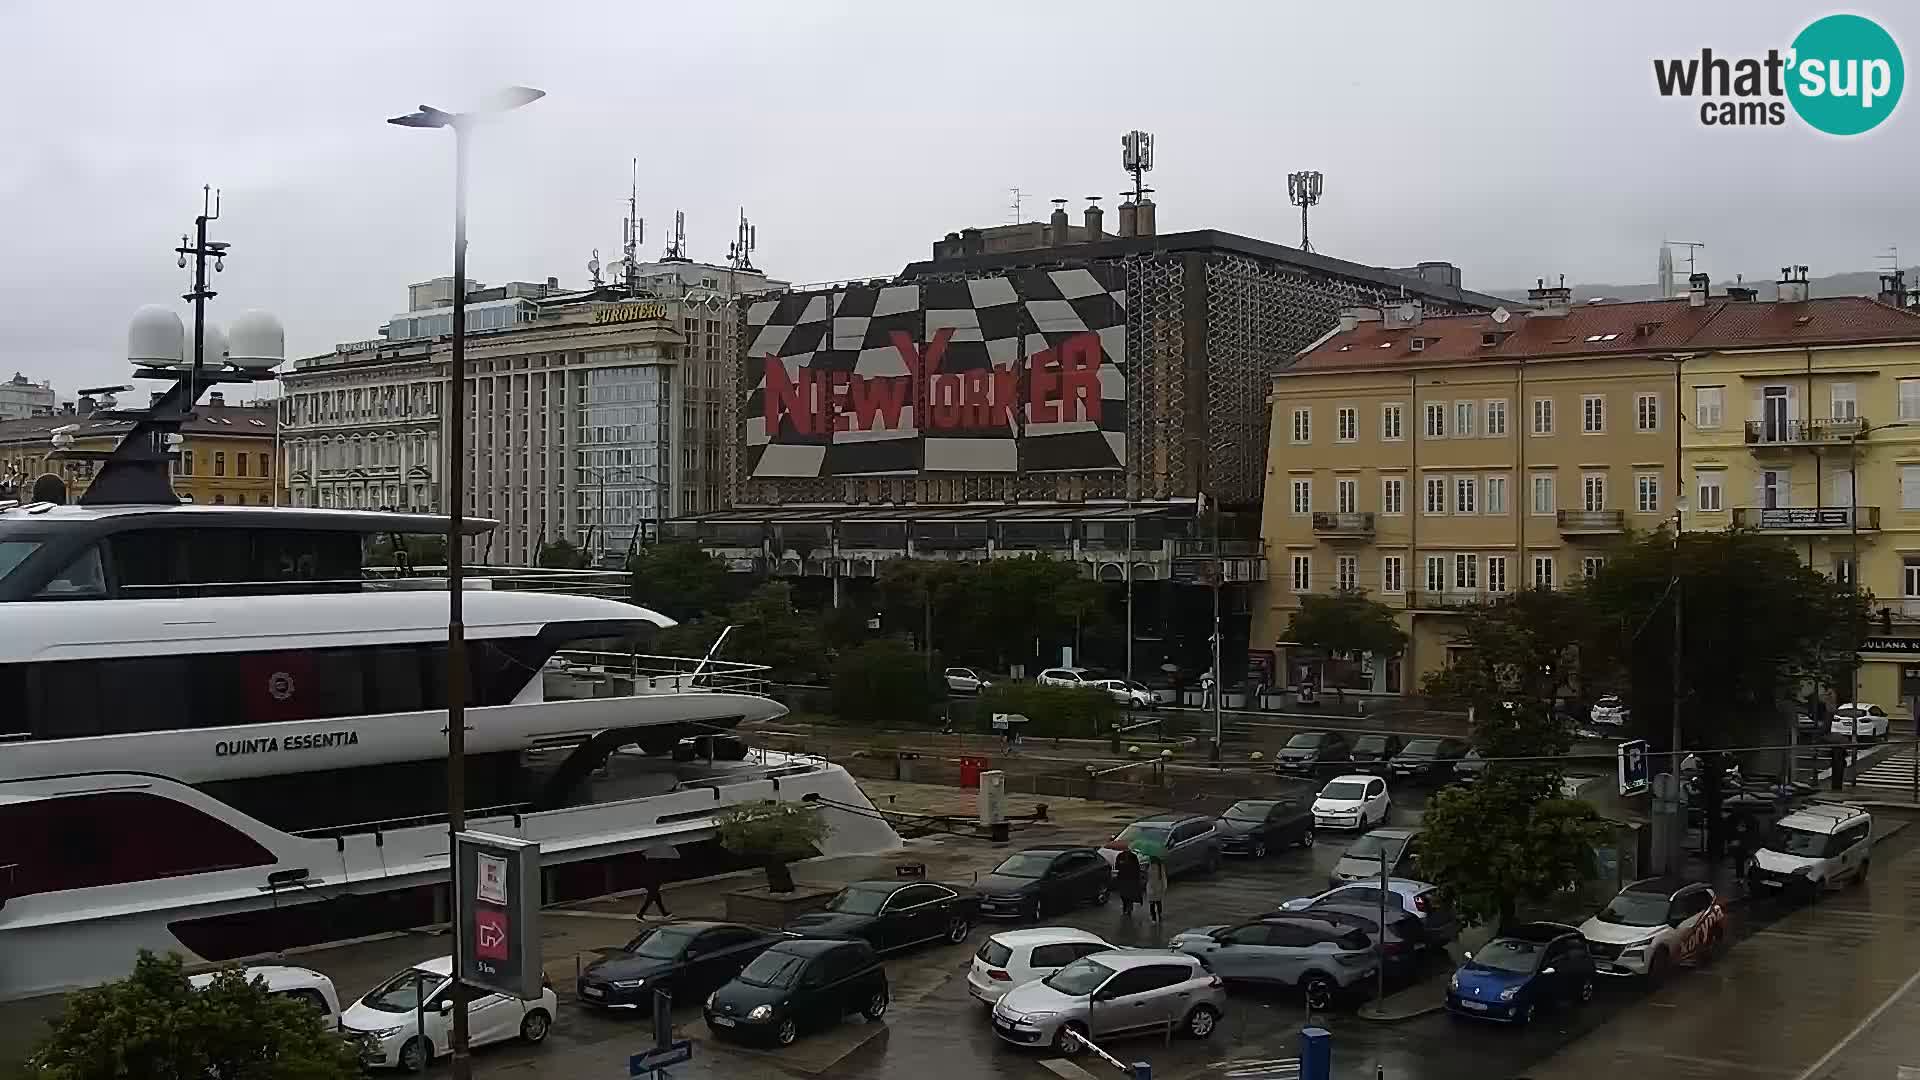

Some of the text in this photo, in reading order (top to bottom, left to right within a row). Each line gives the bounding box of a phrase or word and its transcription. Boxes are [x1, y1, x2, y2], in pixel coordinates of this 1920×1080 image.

[888, 327, 1102, 430] YORKER
[215, 731, 359, 757] QUINTA ESSENTIA
